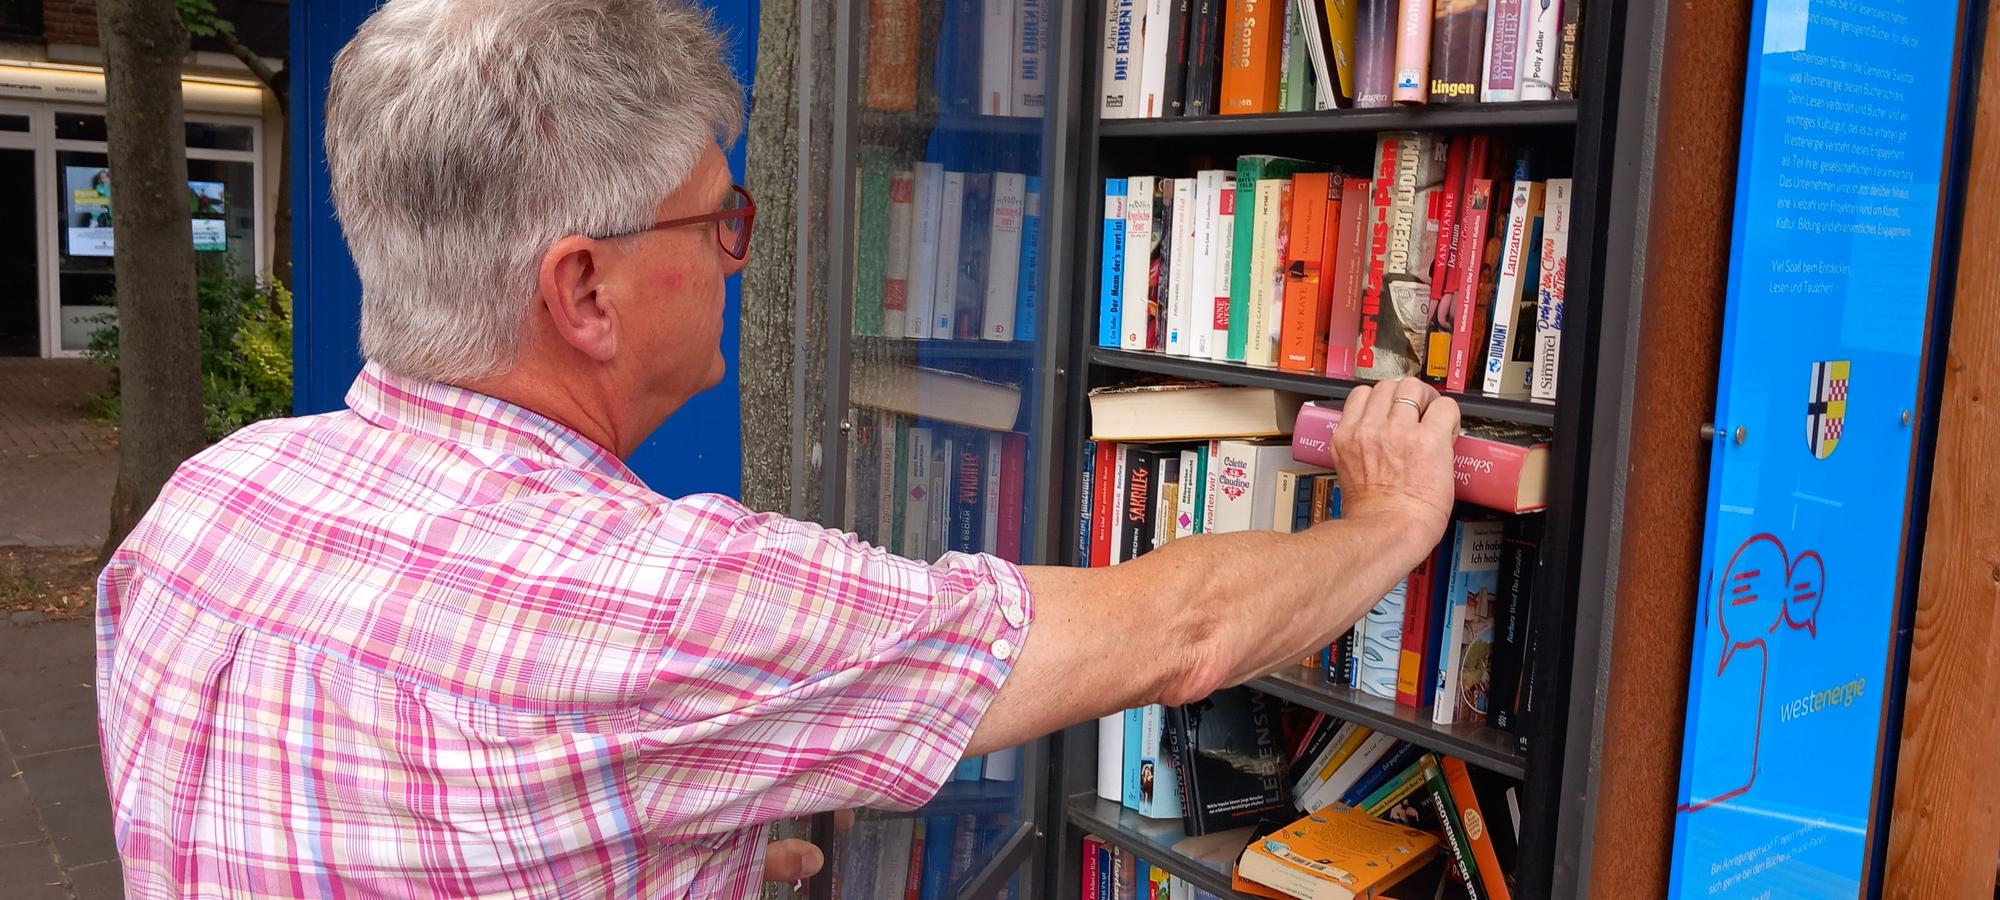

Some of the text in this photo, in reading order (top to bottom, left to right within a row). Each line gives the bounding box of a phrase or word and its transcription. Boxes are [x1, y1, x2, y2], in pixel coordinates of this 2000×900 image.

[1106, 27, 1117, 51] John
[1116, 9, 1132, 54] ERBEN
[1240, 17, 1256, 67] Sonne
[1535, 30, 1545, 53] Adler
[1501, 12, 1519, 81] PILCHER
[1559, 23, 1577, 92] Alexander Bek
[1114, 57, 1128, 81] DIE
[1533, 53, 1544, 79] Polly
[1431, 80, 1475, 97] Lingen
[1388, 138, 1421, 274] ROBERT LUDLUM
[1113, 220, 1121, 230] ist
[1437, 191, 1454, 267] YAN LIANKE
[1113, 232, 1121, 250] wert
[1446, 224, 1460, 268] Der Traum
[1469, 238, 1477, 250] von
[1502, 215, 1523, 278] Lanzarote
[1357, 139, 1399, 369] Der Ikarus-Plan
[1466, 250, 1475, 272] Frauen
[1111, 274, 1119, 296] Mann
[1464, 272, 1472, 283] Die
[1540, 272, 1553, 289] den
[1110, 299, 1118, 312] Der
[1297, 287, 1307, 316] KAYE
[1539, 289, 1552, 305] mit
[1553, 287, 1565, 301] die
[1216, 299, 1225, 326] ANNE
[1537, 305, 1551, 333] Doch
[1490, 322, 1507, 358] DUMONT
[1540, 334, 1556, 389] Simmel
[1299, 436, 1326, 452] Zarin
[1223, 456, 1247, 468] Colette
[1219, 475, 1250, 489] Claudine
[1128, 466, 1148, 523] SAKRILEG
[1206, 471, 1216, 526] warten wir?
[1471, 552, 1482, 564] Ich
[1472, 540, 1483, 552] Ich
[1780, 673, 1867, 724] westenergie
[1432, 790, 1463, 867] NAMENLOSEN
[1457, 859, 1470, 880] DES
